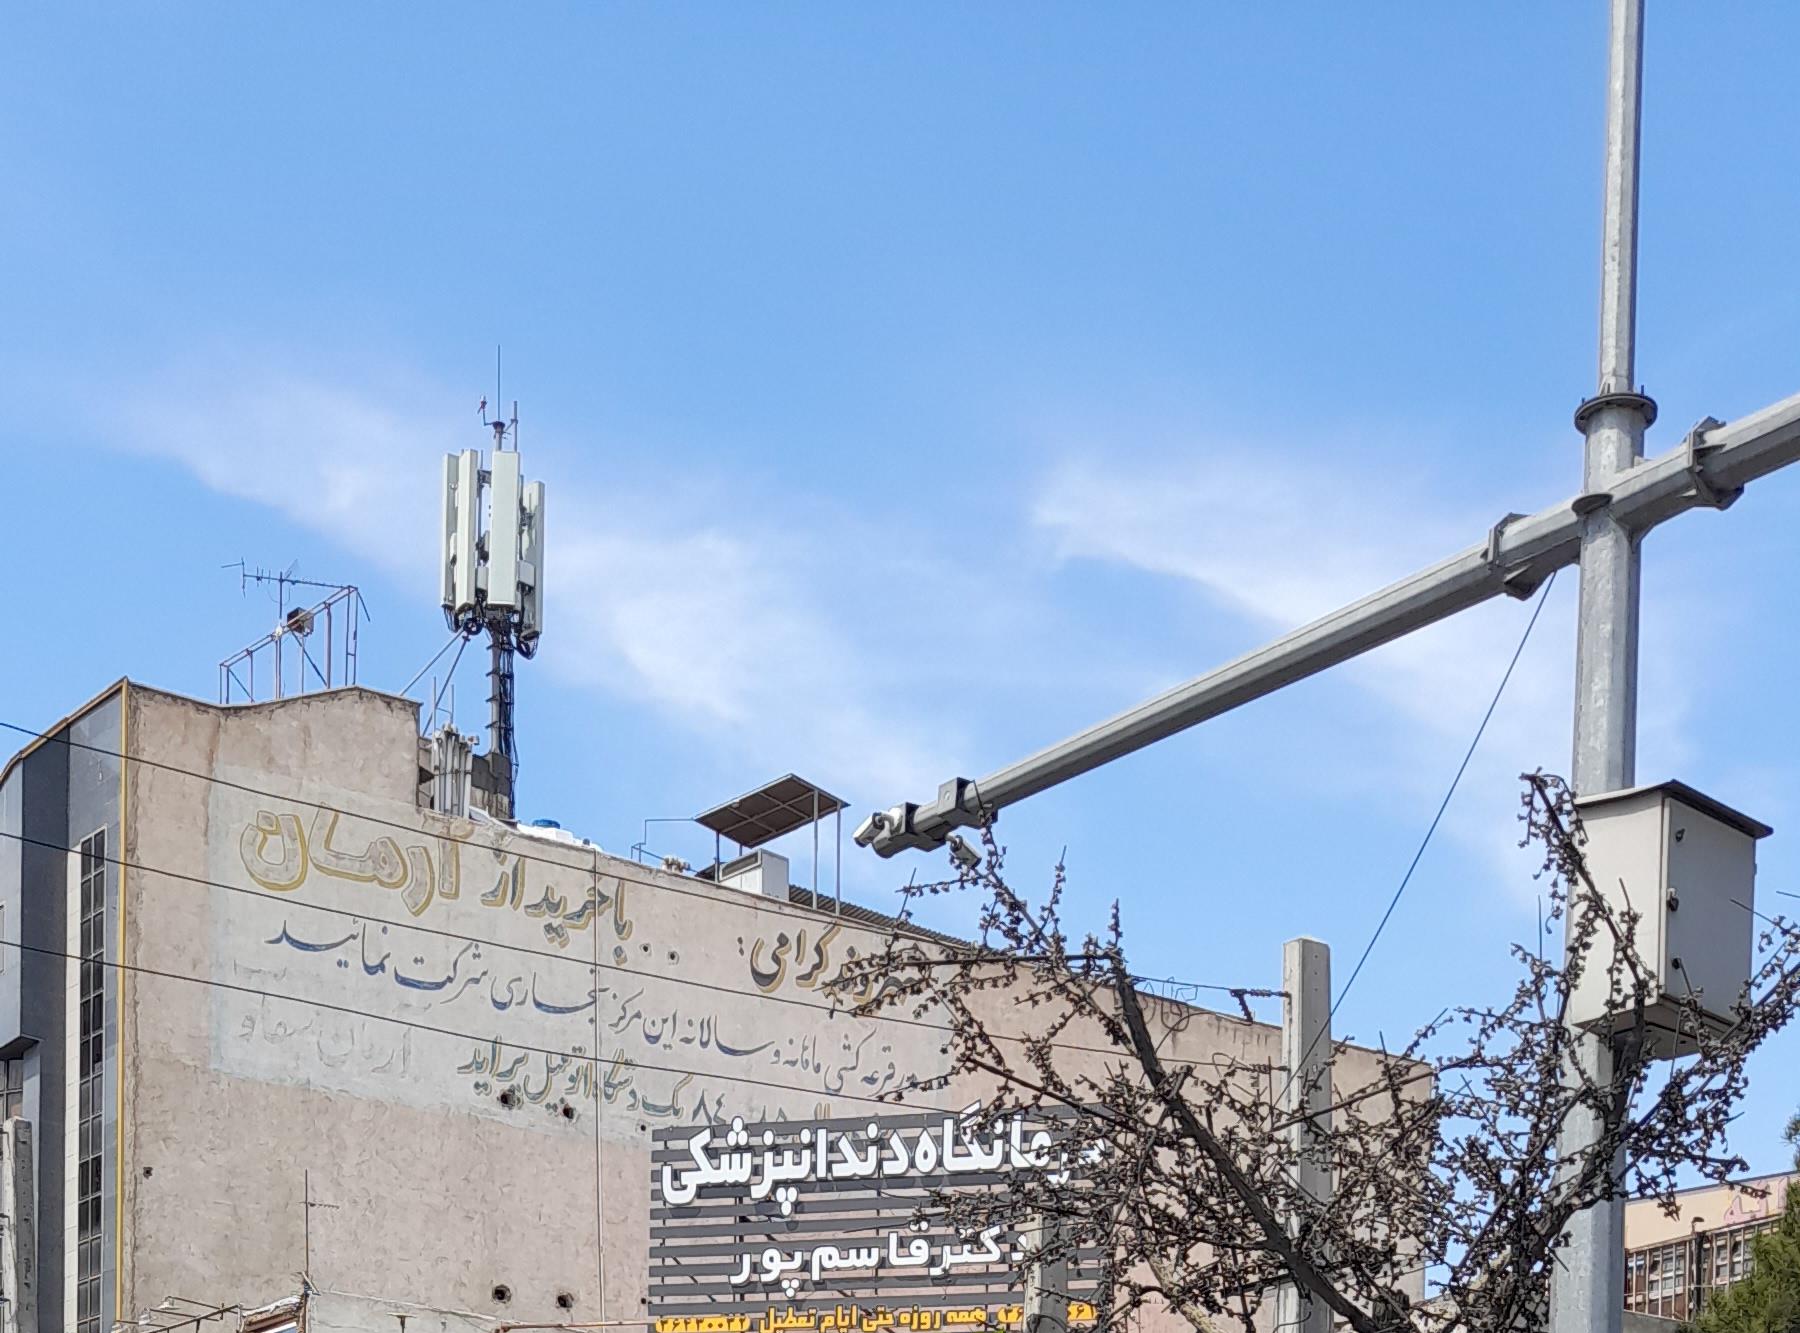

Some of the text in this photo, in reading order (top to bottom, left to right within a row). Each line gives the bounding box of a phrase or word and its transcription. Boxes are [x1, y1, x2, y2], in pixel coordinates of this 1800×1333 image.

[524, 868, 613, 949] خرید
[394, 942, 488, 1005] شرکت
[490, 967, 609, 1025] تجاری
[608, 986, 644, 1034] مرکز
[642, 1008, 677, 1051] این
[661, 1116, 912, 1217] دندانپزشکی
[818, 1304, 858, 1333] ایام
[861, 1305, 894, 1333] حتی
[899, 1305, 942, 1331] روزه
[946, 1306, 987, 1323] همه
